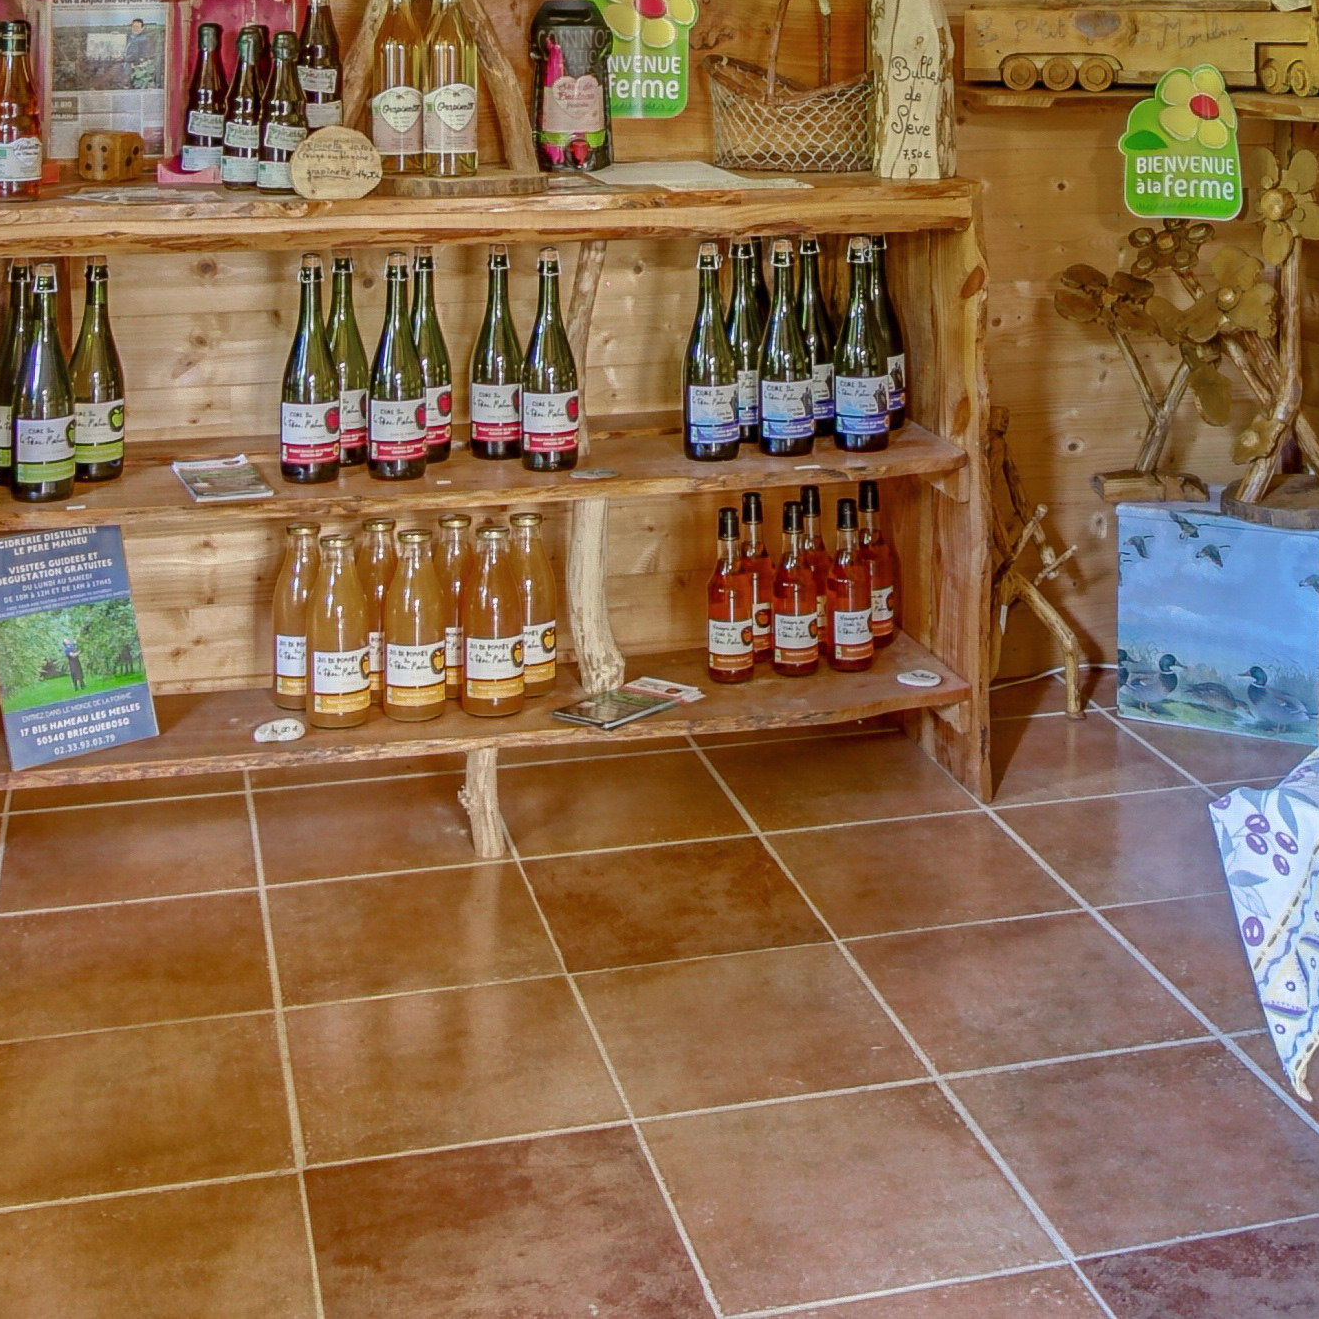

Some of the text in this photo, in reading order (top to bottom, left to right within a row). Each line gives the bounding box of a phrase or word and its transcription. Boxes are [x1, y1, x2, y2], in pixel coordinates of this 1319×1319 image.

[607, 56, 681, 74] NVENUE
[889, 55, 938, 83] Bulle
[904, 85, 922, 102] de
[891, 104, 931, 136] Sève
[1136, 155, 1235, 176] BIENVENUE
[1136, 174, 1235, 201] à la ferme
[43, 526, 97, 542] DISTILLERIE
[14, 536, 88, 556] LE PERE MAHIEU
[8, 552, 98, 575] VISITES GUIDEES ET
[64, 558, 113, 574] GRATUITES
[22, 573, 93, 592] DU LUNDI AU SAMEDI
[3, 596, 14, 604] DE
[20, 702, 141, 738] 17 BIS HAMEAU LES MESLES
[67, 716, 130, 740] BRICQUEBOSQ
